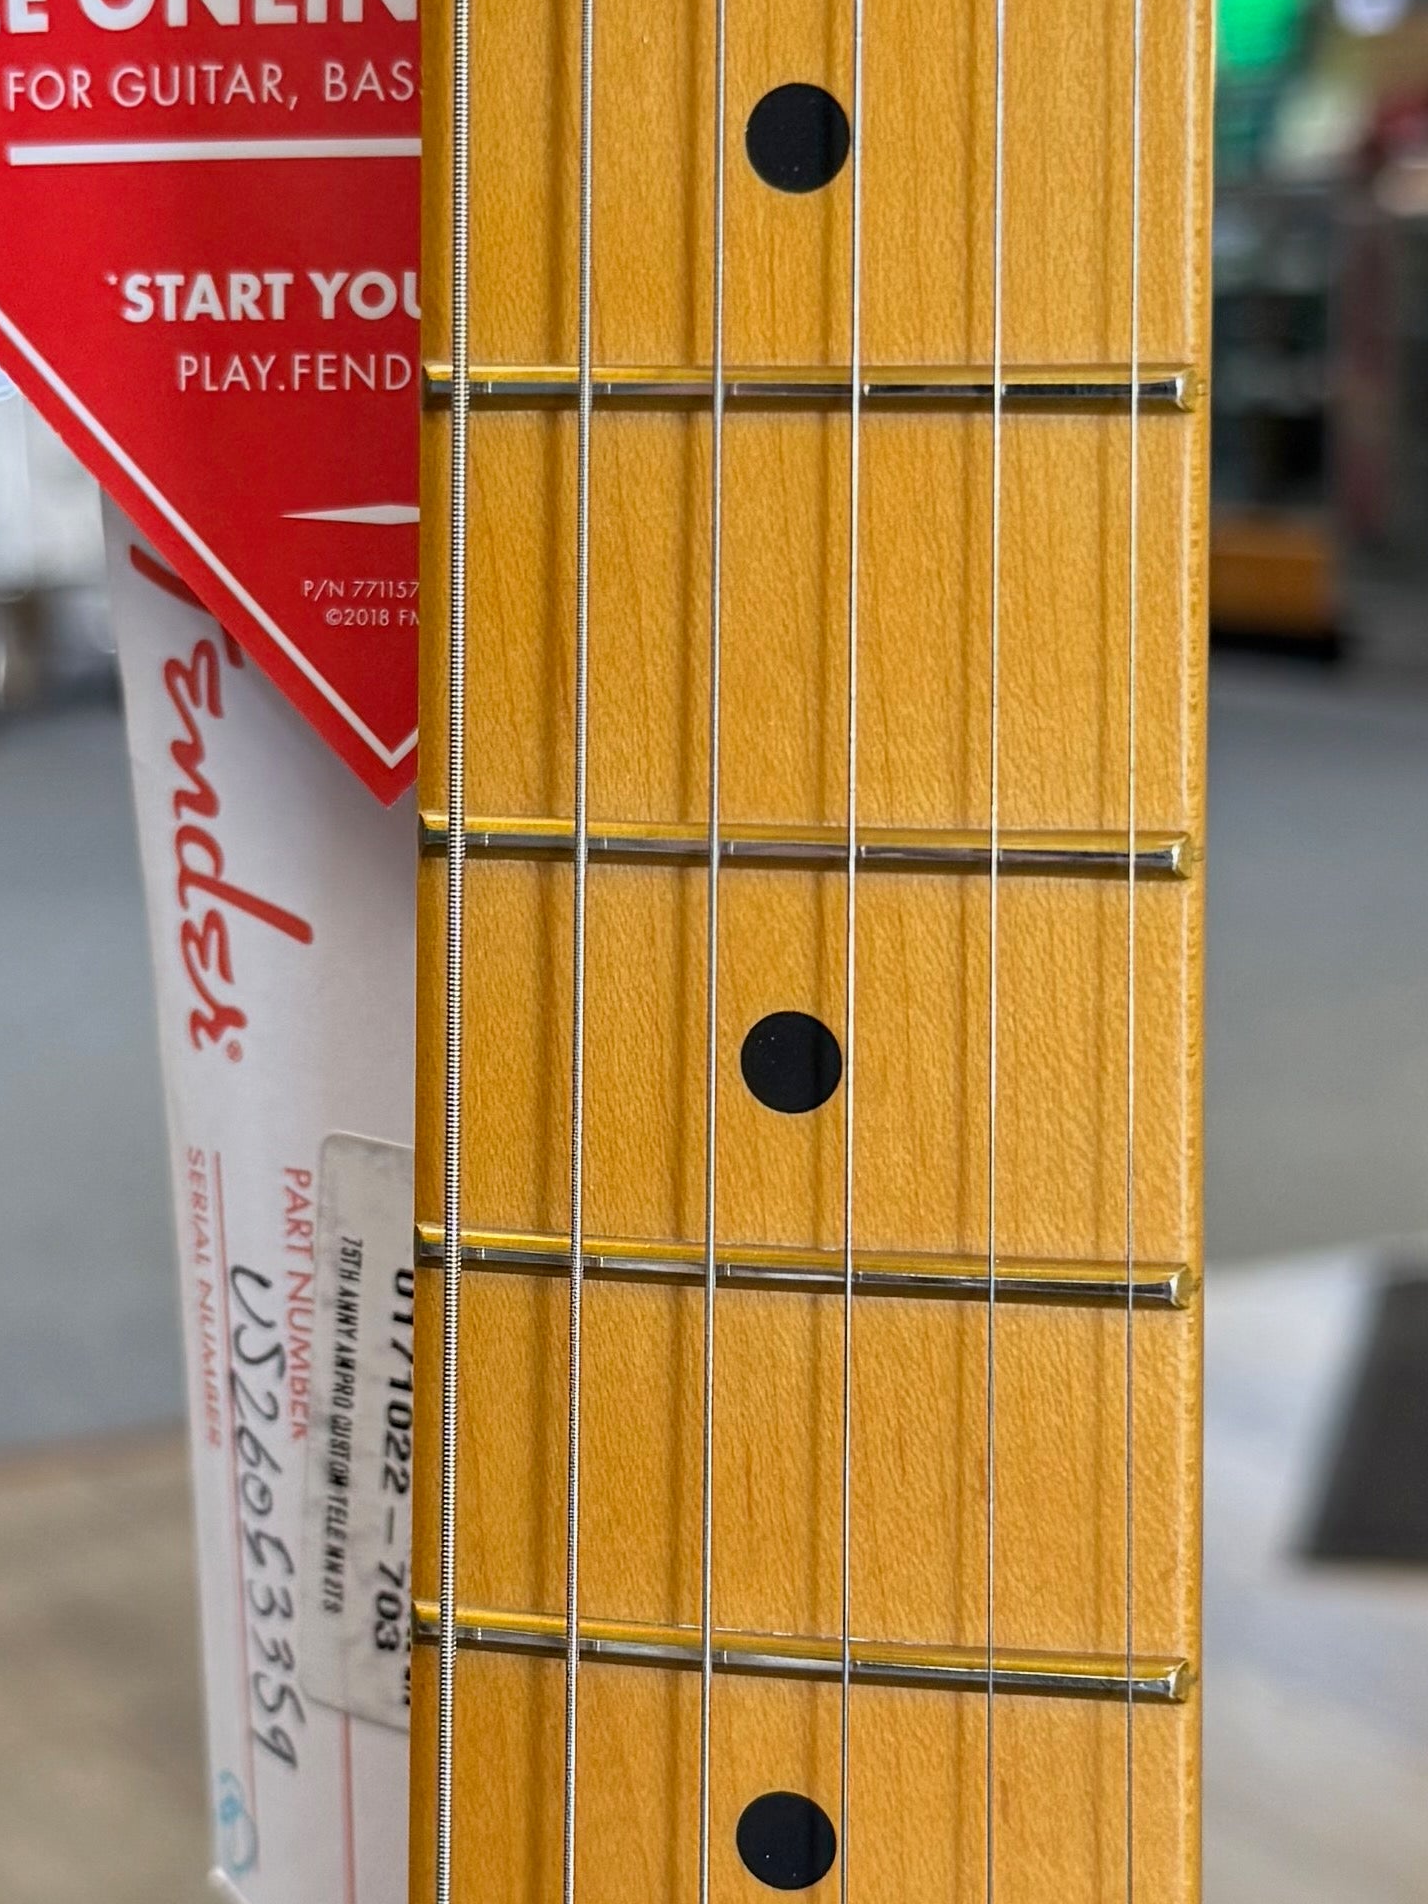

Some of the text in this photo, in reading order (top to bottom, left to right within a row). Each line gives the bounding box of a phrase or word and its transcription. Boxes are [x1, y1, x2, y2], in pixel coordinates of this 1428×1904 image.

[8, 61, 420, 110] FOR GUITAR, BAS
[122, 273, 294, 323] START
[178, 354, 412, 393] PLAY.FEND
[303, 580, 344, 602] P/N
[326, 608, 390, 627] ©2018
[187, 1147, 209, 1264] SERIAL
[284, 1166, 314, 1260] PART
[326, 1495, 349, 1540] TELE
